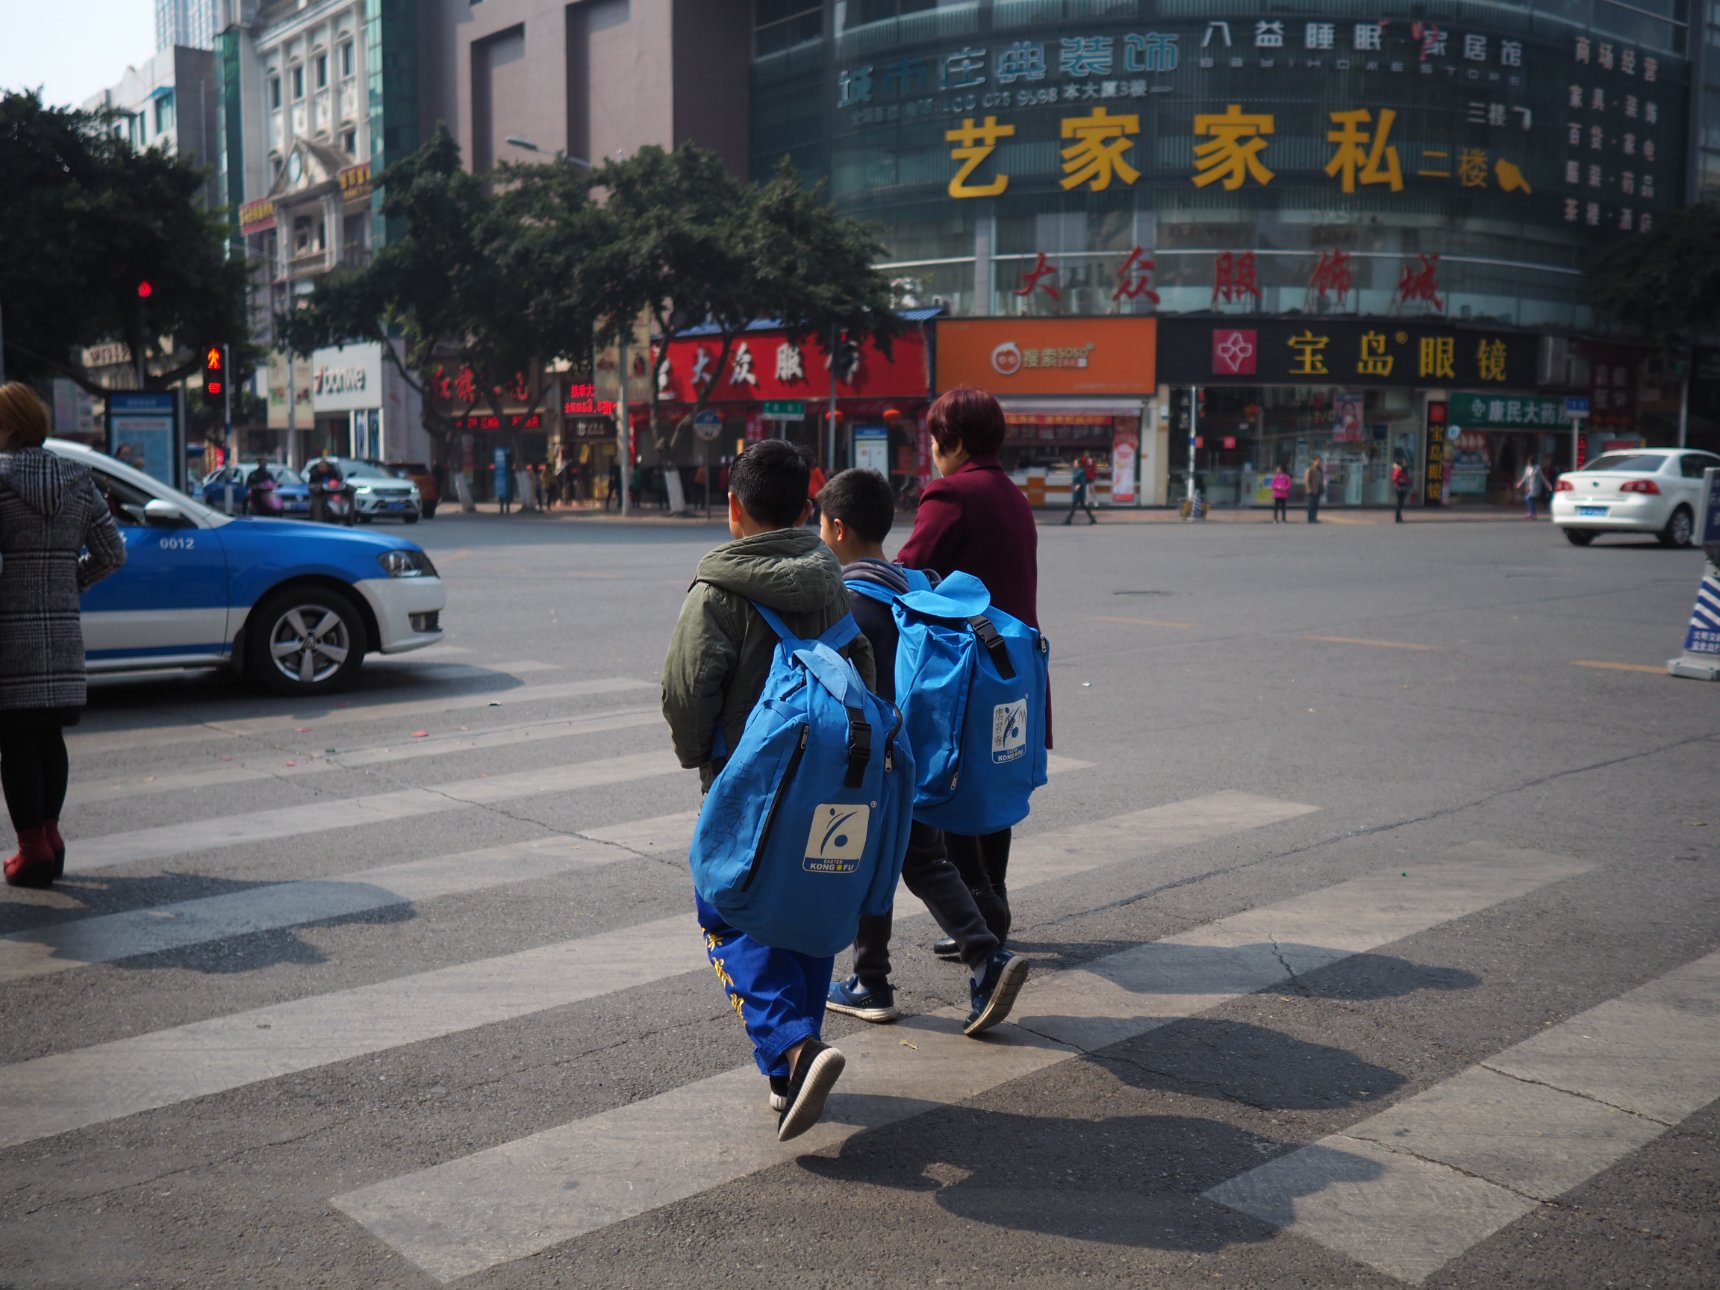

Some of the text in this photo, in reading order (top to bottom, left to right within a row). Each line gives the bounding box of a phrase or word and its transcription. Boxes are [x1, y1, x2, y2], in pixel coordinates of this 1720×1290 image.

[945, 104, 1403, 200] 艺家家私
[1416, 147, 1489, 190] 二楼
[1013, 247, 1443, 308] 大众服饰城
[159, 537, 195, 550] 0012
